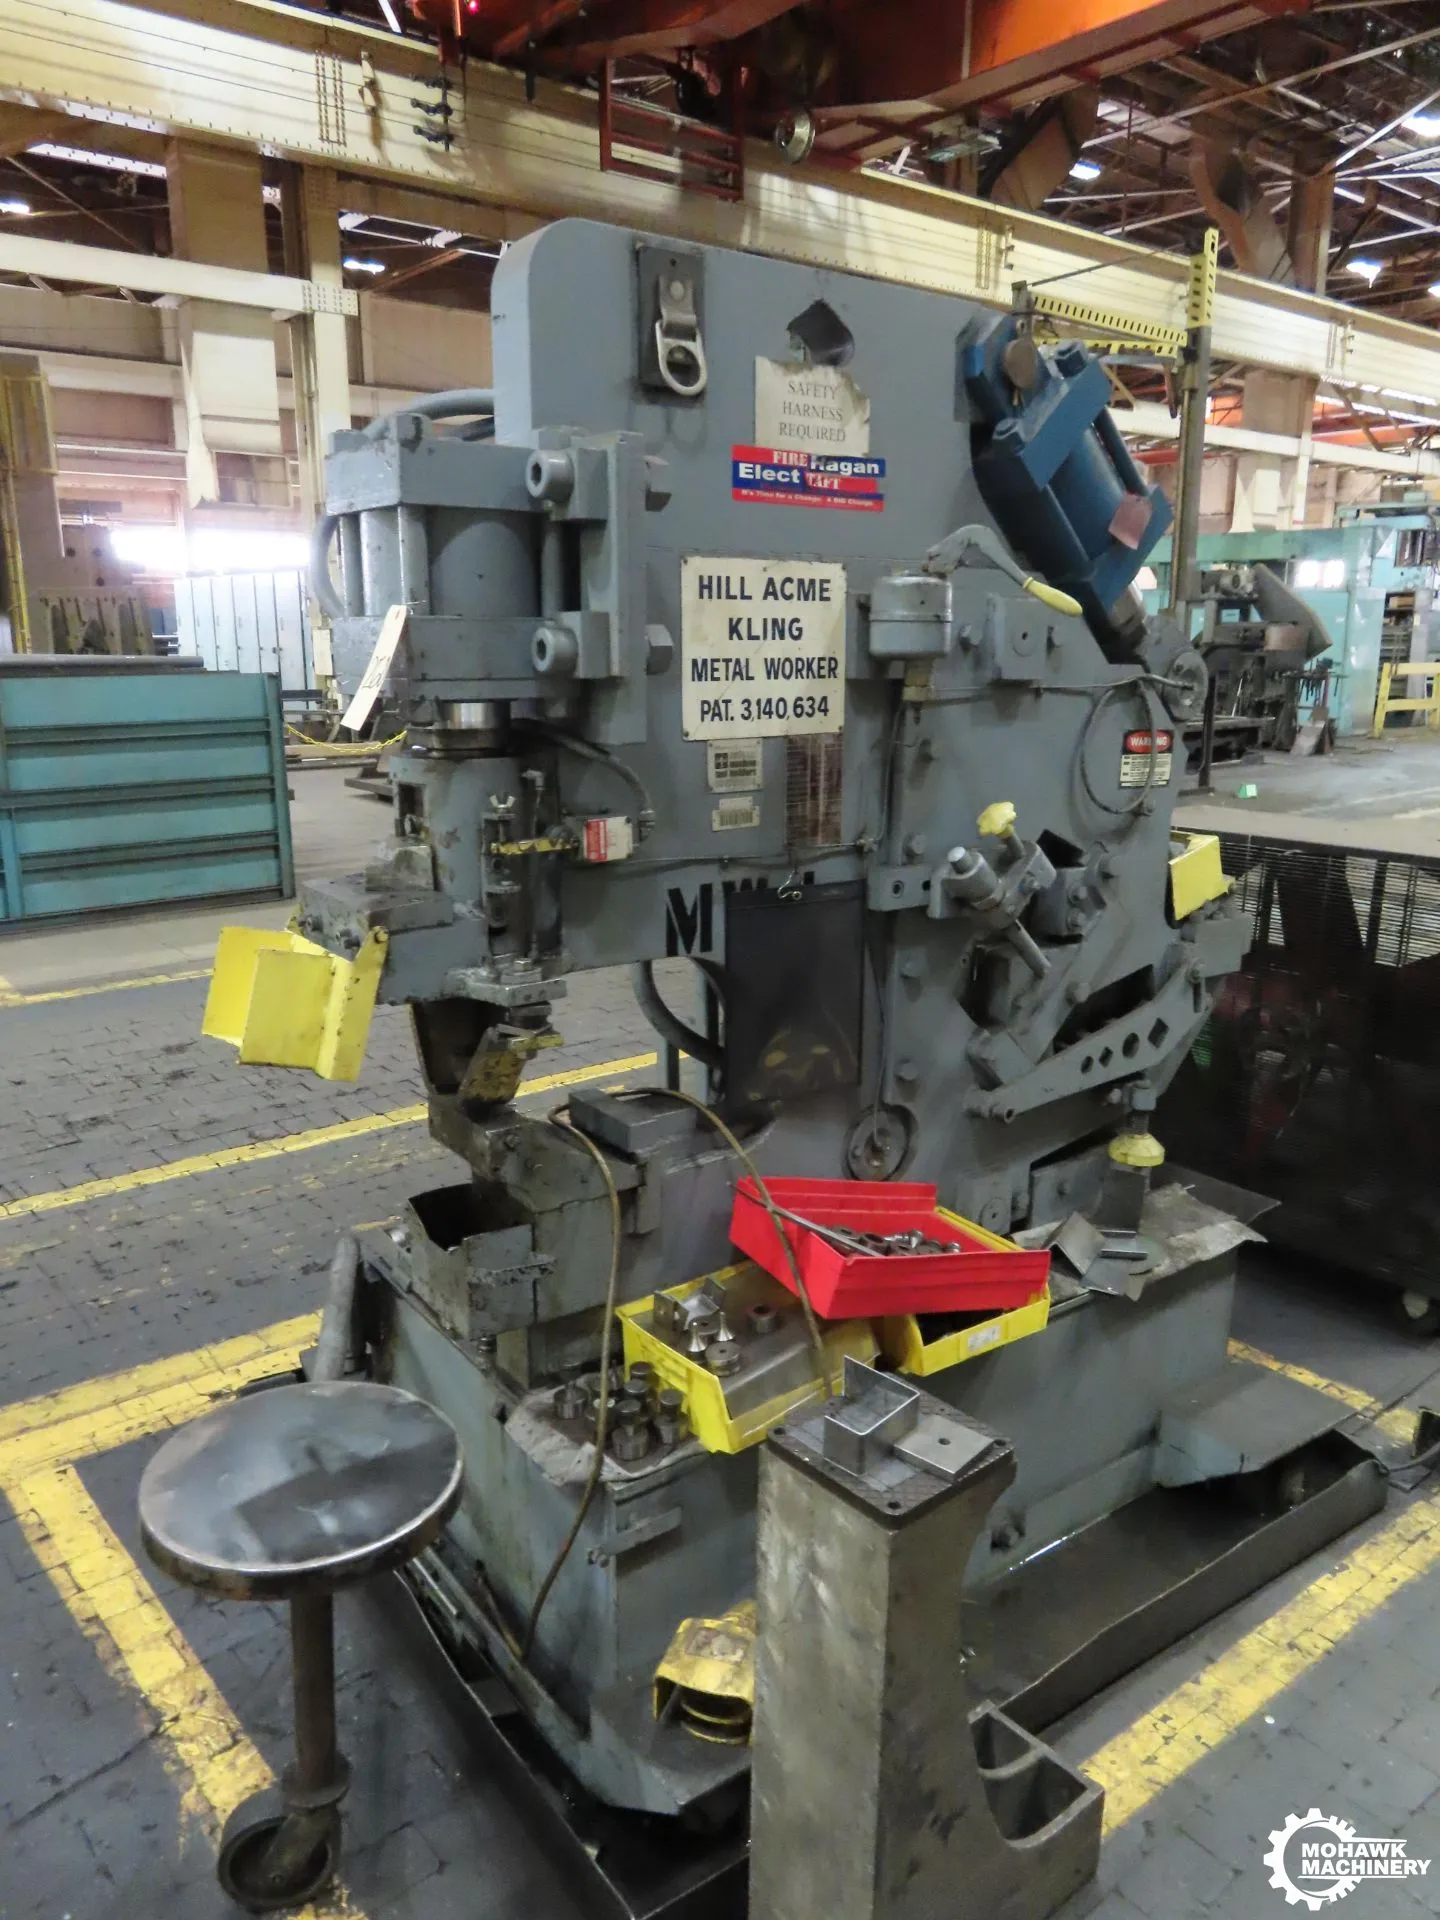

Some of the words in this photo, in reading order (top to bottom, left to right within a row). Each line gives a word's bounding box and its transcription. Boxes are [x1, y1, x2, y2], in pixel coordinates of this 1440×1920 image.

[788, 381, 838, 400] SAFETY
[782, 401, 844, 421] HARNESS
[778, 422, 846, 442] REQUIRED
[773, 450, 809, 467] FIRE
[738, 462, 801, 483] Elect
[806, 472, 842, 490] TAFT
[699, 575, 752, 600] HILL
[763, 577, 831, 602] ACME
[729, 617, 803, 641] KLING
[691, 657, 755, 682] METAL
[764, 657, 838, 681] WORKER
[701, 699, 734, 722] PAT.
[741, 696, 829, 722] 3,140,634
[1130, 736, 1168, 747] WARNNG
